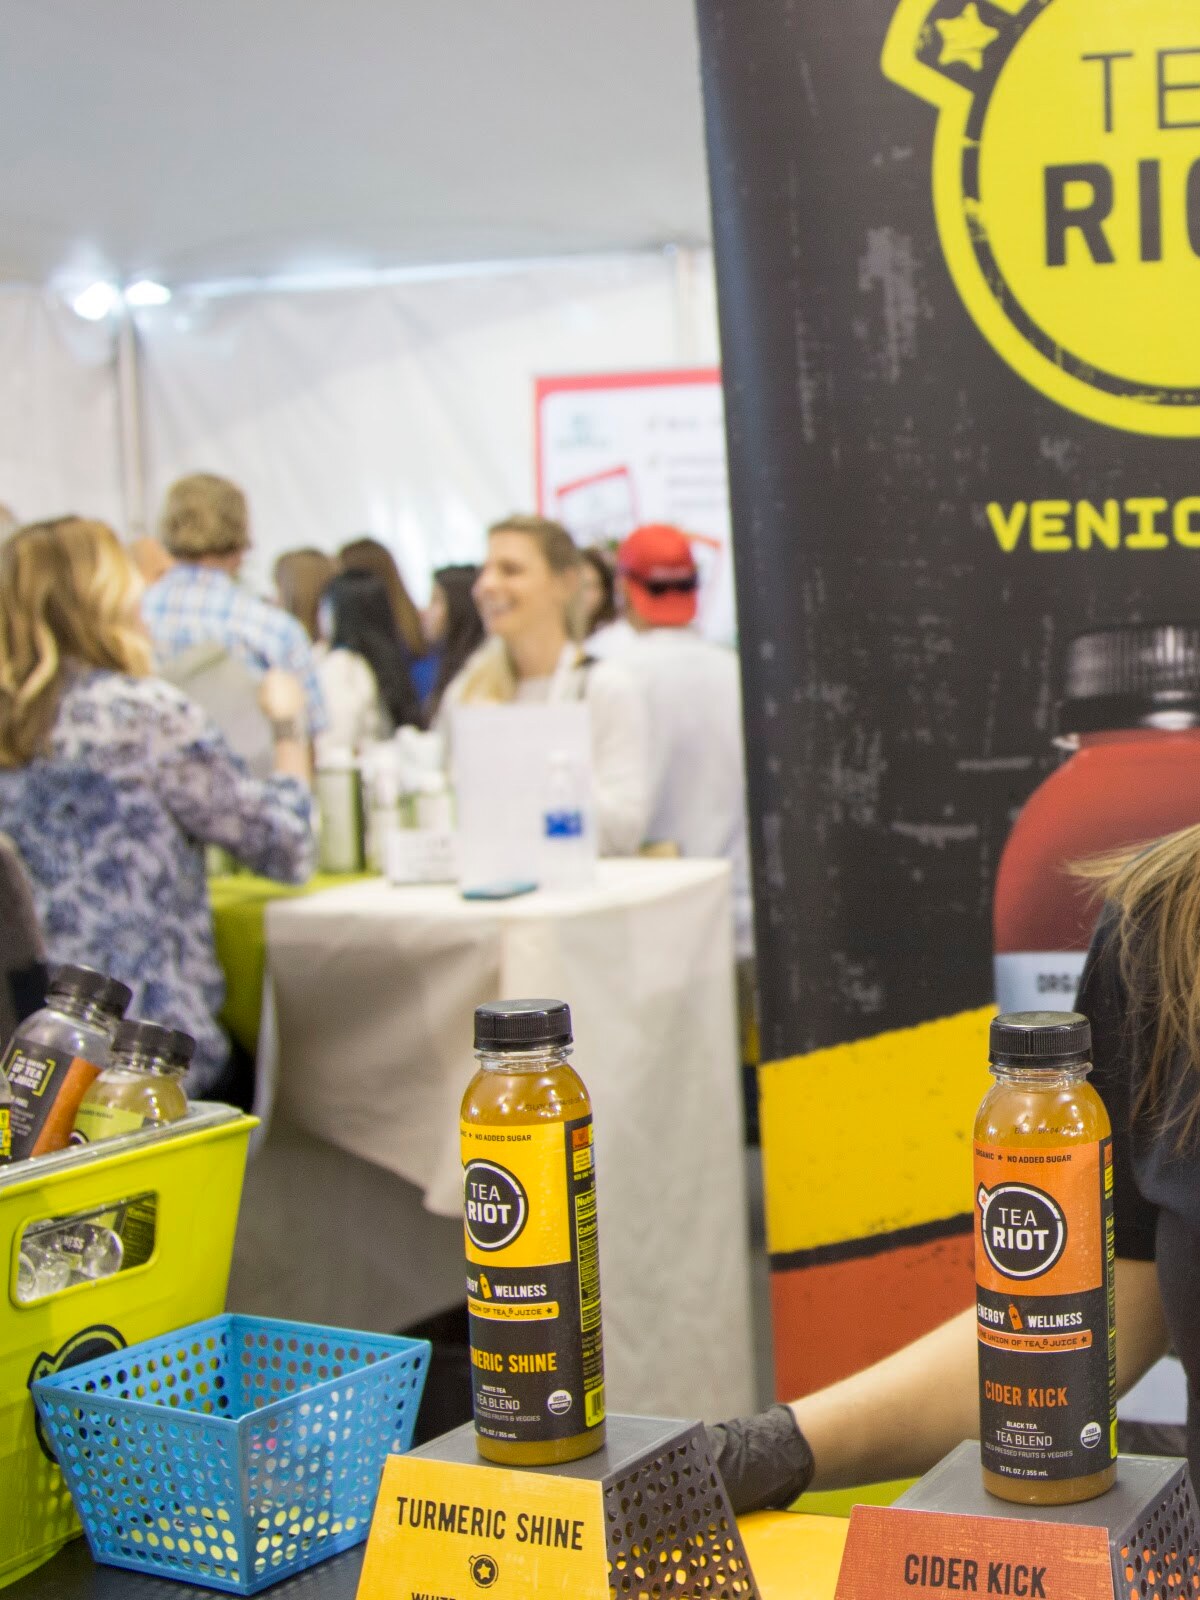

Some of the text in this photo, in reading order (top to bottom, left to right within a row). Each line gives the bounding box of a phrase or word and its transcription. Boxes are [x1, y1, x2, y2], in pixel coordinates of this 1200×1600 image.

[475, 1133, 483, 1141] NO
[484, 1134, 505, 1142] ADDED
[507, 1134, 531, 1142] SUGAR
[1007, 1155, 1017, 1163] NO
[1019, 1155, 1045, 1164] ADDED
[1045, 1154, 1072, 1163] SUGAR
[470, 1182, 501, 1201] TEA
[468, 1200, 511, 1224] RIOT
[998, 1207, 1038, 1227] TEA
[992, 1226, 1050, 1251] RIOT
[494, 1284, 547, 1298] WELLNESS
[493, 1308, 509, 1317] TEA
[978, 1303, 1083, 1328] ENERGY WELLNESS
[988, 1335, 1009, 1345] UNION
[1023, 1341, 1044, 1349] TEA
[1050, 1338, 1078, 1347] JUICE
[471, 1347, 557, 1373] MERIC SHINE
[984, 1380, 1069, 1408] CIDER KICK
[489, 1397, 520, 1410] BLEND
[1006, 1421, 1037, 1430] BLACK TEA
[995, 1430, 1053, 1447] TEA BLEND
[1018, 1451, 1040, 1459] FRUITS
[1047, 1450, 1073, 1459] VEGGIES
[397, 1496, 585, 1551] TURMERIC SHINE
[904, 1554, 1047, 1599] CIDER KICK
